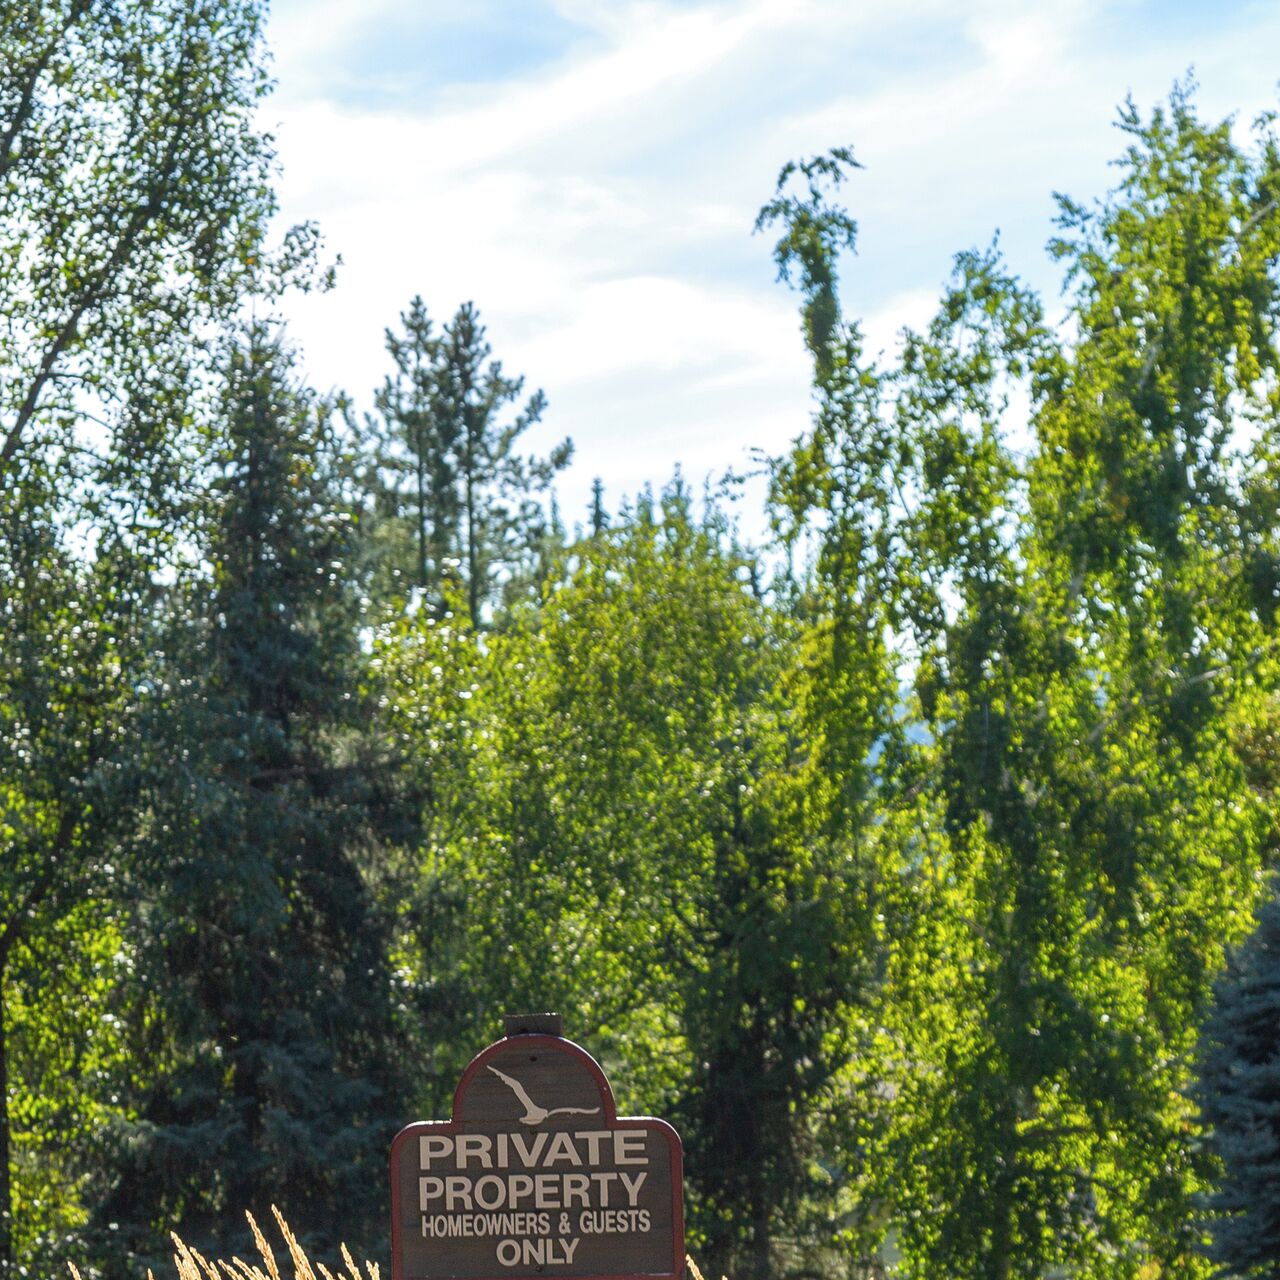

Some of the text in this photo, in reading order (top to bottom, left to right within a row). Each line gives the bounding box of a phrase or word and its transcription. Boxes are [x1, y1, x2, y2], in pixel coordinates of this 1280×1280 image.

[419, 1129, 649, 1170] PRIVATE
[418, 1171, 648, 1211] PROPERTY
[421, 1209, 651, 1238] HOMEOWNERS & GUESTS
[495, 1237, 580, 1267] ONLY
